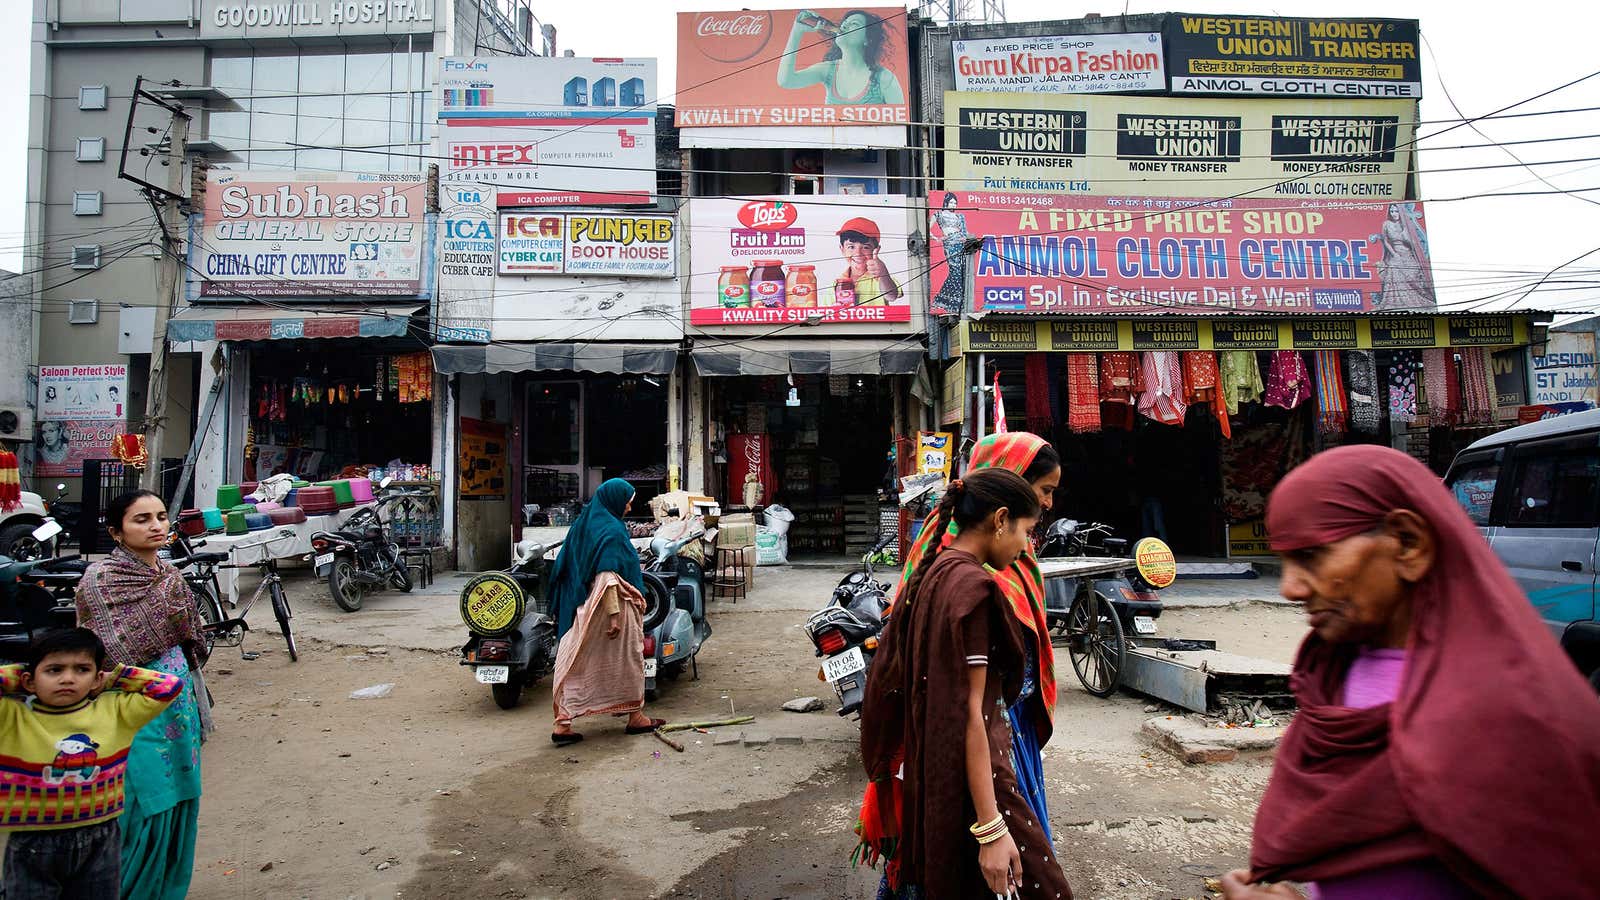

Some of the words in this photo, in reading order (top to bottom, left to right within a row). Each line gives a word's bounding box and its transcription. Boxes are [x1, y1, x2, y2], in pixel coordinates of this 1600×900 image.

[214, 2, 323, 27] GOODWILL
[330, 0, 433, 24] HOSPITAL
[697, 15, 768, 36] Coca-Cola
[1180, 17, 1290, 37] WESTERN
[1309, 21, 1385, 39] MONEY
[993, 44, 1019, 52] FIXED
[1023, 42, 1054, 51] PRICE
[1060, 41, 1094, 50] SHOP
[1217, 37, 1293, 56] UNION
[1310, 40, 1416, 60] TRANSFER
[958, 56, 1008, 77] Guru
[1010, 53, 1073, 77] Kirpa
[1077, 49, 1160, 72] Fashion
[968, 77, 997, 85] RAMA
[1039, 72, 1105, 83] JALANDHAR
[1107, 71, 1152, 81] CANTT
[1184, 78, 1253, 90] ANMOL
[1261, 80, 1326, 93] CLOTH
[1333, 82, 1411, 95] CENTRE
[679, 108, 764, 125] KWALITY
[770, 107, 836, 124] SUPER
[840, 107, 907, 122] STORE
[968, 111, 1061, 131] WESTERN
[1126, 118, 1217, 138] WESTERN
[1280, 119, 1371, 138] WESTERN
[999, 132, 1061, 152] UNION
[1155, 138, 1217, 157] UNION
[1309, 138, 1371, 156] UNION
[541, 152, 573, 160] COMPUTER
[575, 151, 614, 159] PERIPHERALS
[972, 155, 1012, 166] MONEY
[1016, 156, 1073, 168] TRANSFER
[1129, 162, 1167, 172] MONEY
[1170, 163, 1227, 173] TRANSFER
[1283, 163, 1323, 172] MONEY
[1325, 163, 1381, 173] TRANSFER
[218, 176, 234, 185] New
[448, 172, 498, 181] DEMAND
[507, 171, 539, 180] MORE
[1275, 182, 1312, 195] ANMOL
[1314, 182, 1348, 196] CLOTH
[1351, 183, 1392, 196] CENTRE
[221, 184, 409, 219] Subhash
[457, 191, 481, 203] ICA
[518, 196, 533, 204] ICA
[534, 195, 580, 204] COMPUTER
[989, 195, 1054, 206] 0181-2412468
[747, 201, 786, 224] Tops
[506, 216, 562, 239] ICA
[1018, 207, 1039, 231] A
[1050, 209, 1134, 233] FIXED
[1144, 210, 1233, 234] PRICE
[1243, 211, 1324, 234] SHOP
[215, 220, 324, 241] GENERAL
[334, 221, 414, 243] STORE
[444, 219, 495, 240] ICA
[570, 217, 674, 247] PUNJAB
[443, 240, 495, 252] COMPUTERS
[501, 239, 539, 250] COMPUTER
[539, 238, 563, 250] CENTRE
[731, 232, 768, 247] Fruit
[773, 231, 805, 247] Jam
[271, 242, 281, 251] &
[571, 245, 615, 259] BOOT
[619, 246, 669, 260] HOUSE
[774, 248, 806, 256] FLAVOURS
[444, 252, 493, 264] EDUCATION
[501, 251, 537, 263] CYBER
[539, 251, 563, 263] CAFE
[977, 235, 1108, 278] ANMOL
[1115, 236, 1230, 280] CLOTH
[1238, 237, 1372, 281] CENTRE
[207, 253, 251, 276] CHINA
[254, 253, 287, 276] GIFT
[291, 253, 347, 275] CENTRE
[442, 264, 469, 276] CYBER
[471, 265, 494, 277] CAFE
[986, 289, 1024, 302] OCM
[1029, 285, 1070, 310] Spl.
[1073, 286, 1090, 306] in
[1105, 286, 1198, 307] Exclusive
[1203, 286, 1239, 309] Daj
[1241, 287, 1258, 307] &
[1261, 287, 1312, 307] Wari
[722, 308, 785, 322] KWALITY
[787, 307, 836, 322] SUPER
[838, 307, 886, 320] STORE
[971, 323, 1030, 333] WESTERN
[1294, 321, 1350, 331] WESTERN
[1450, 318, 1507, 328] WESTERN
[990, 332, 1030, 342] UNION
[1313, 330, 1351, 340] UNION
[1469, 327, 1508, 337] UNION
[41, 367, 70, 377] Saloon
[72, 366, 102, 377] Perfect
[104, 366, 126, 378] Style
[70, 429, 94, 442] Fine
